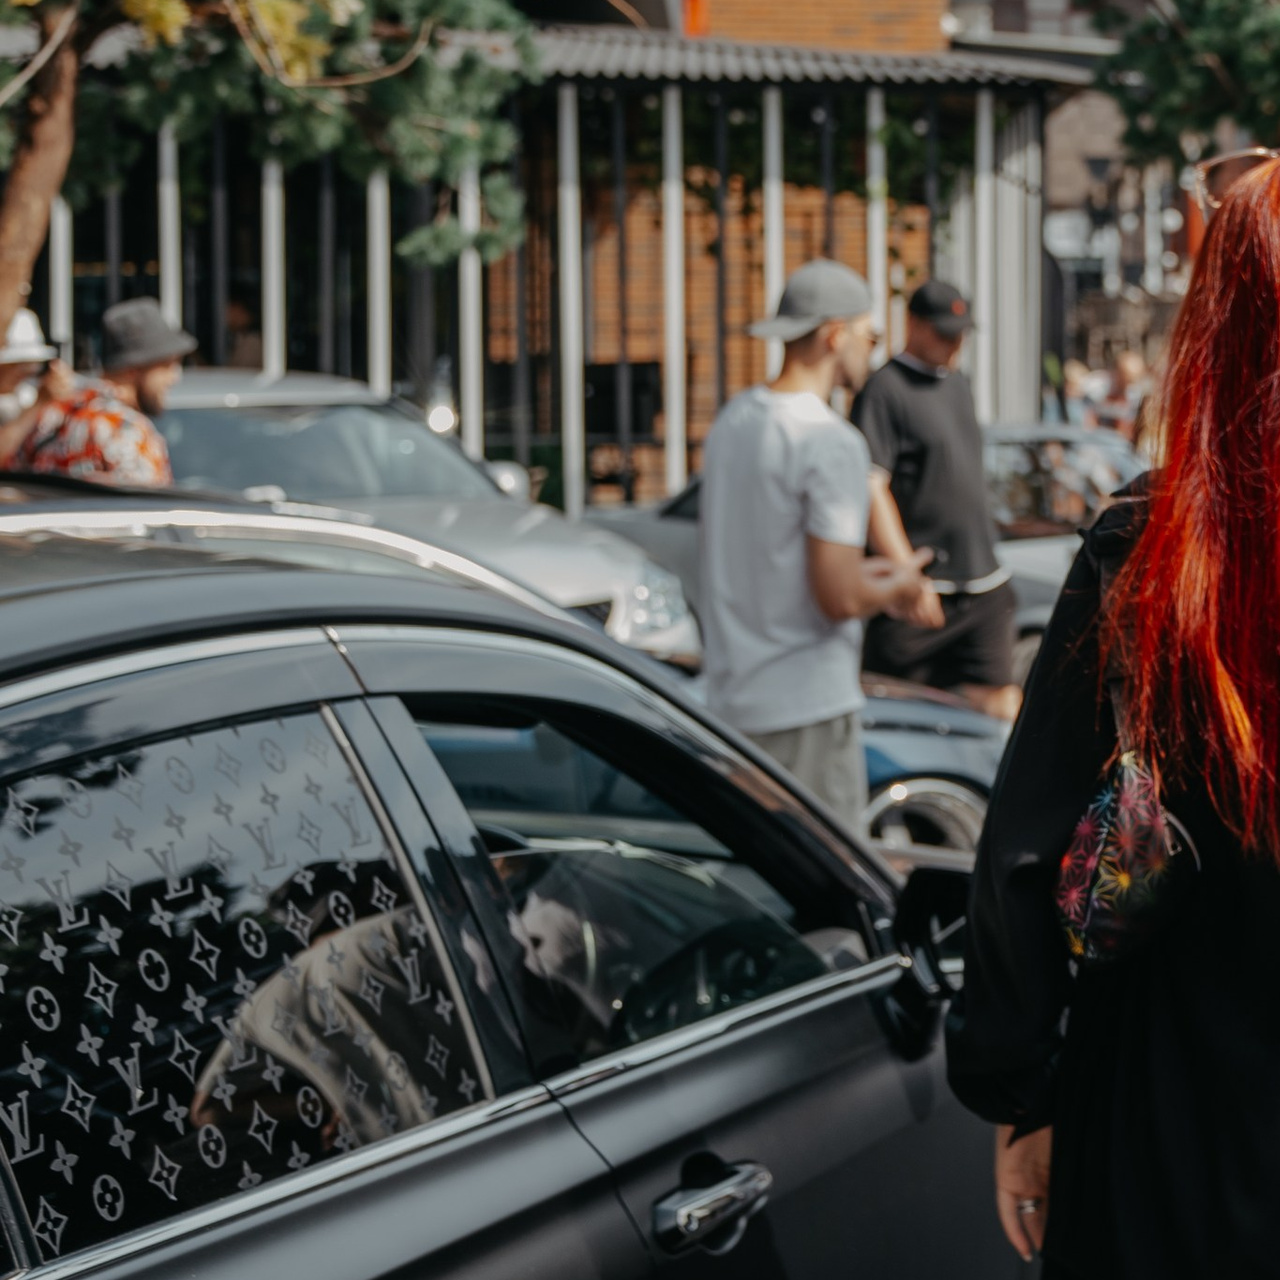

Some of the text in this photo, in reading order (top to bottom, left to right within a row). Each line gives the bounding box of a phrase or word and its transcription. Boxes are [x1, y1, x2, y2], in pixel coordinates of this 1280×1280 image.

[143, 841, 194, 901] LV
[35, 870, 90, 933] LV
[392, 949, 431, 1005] LV
